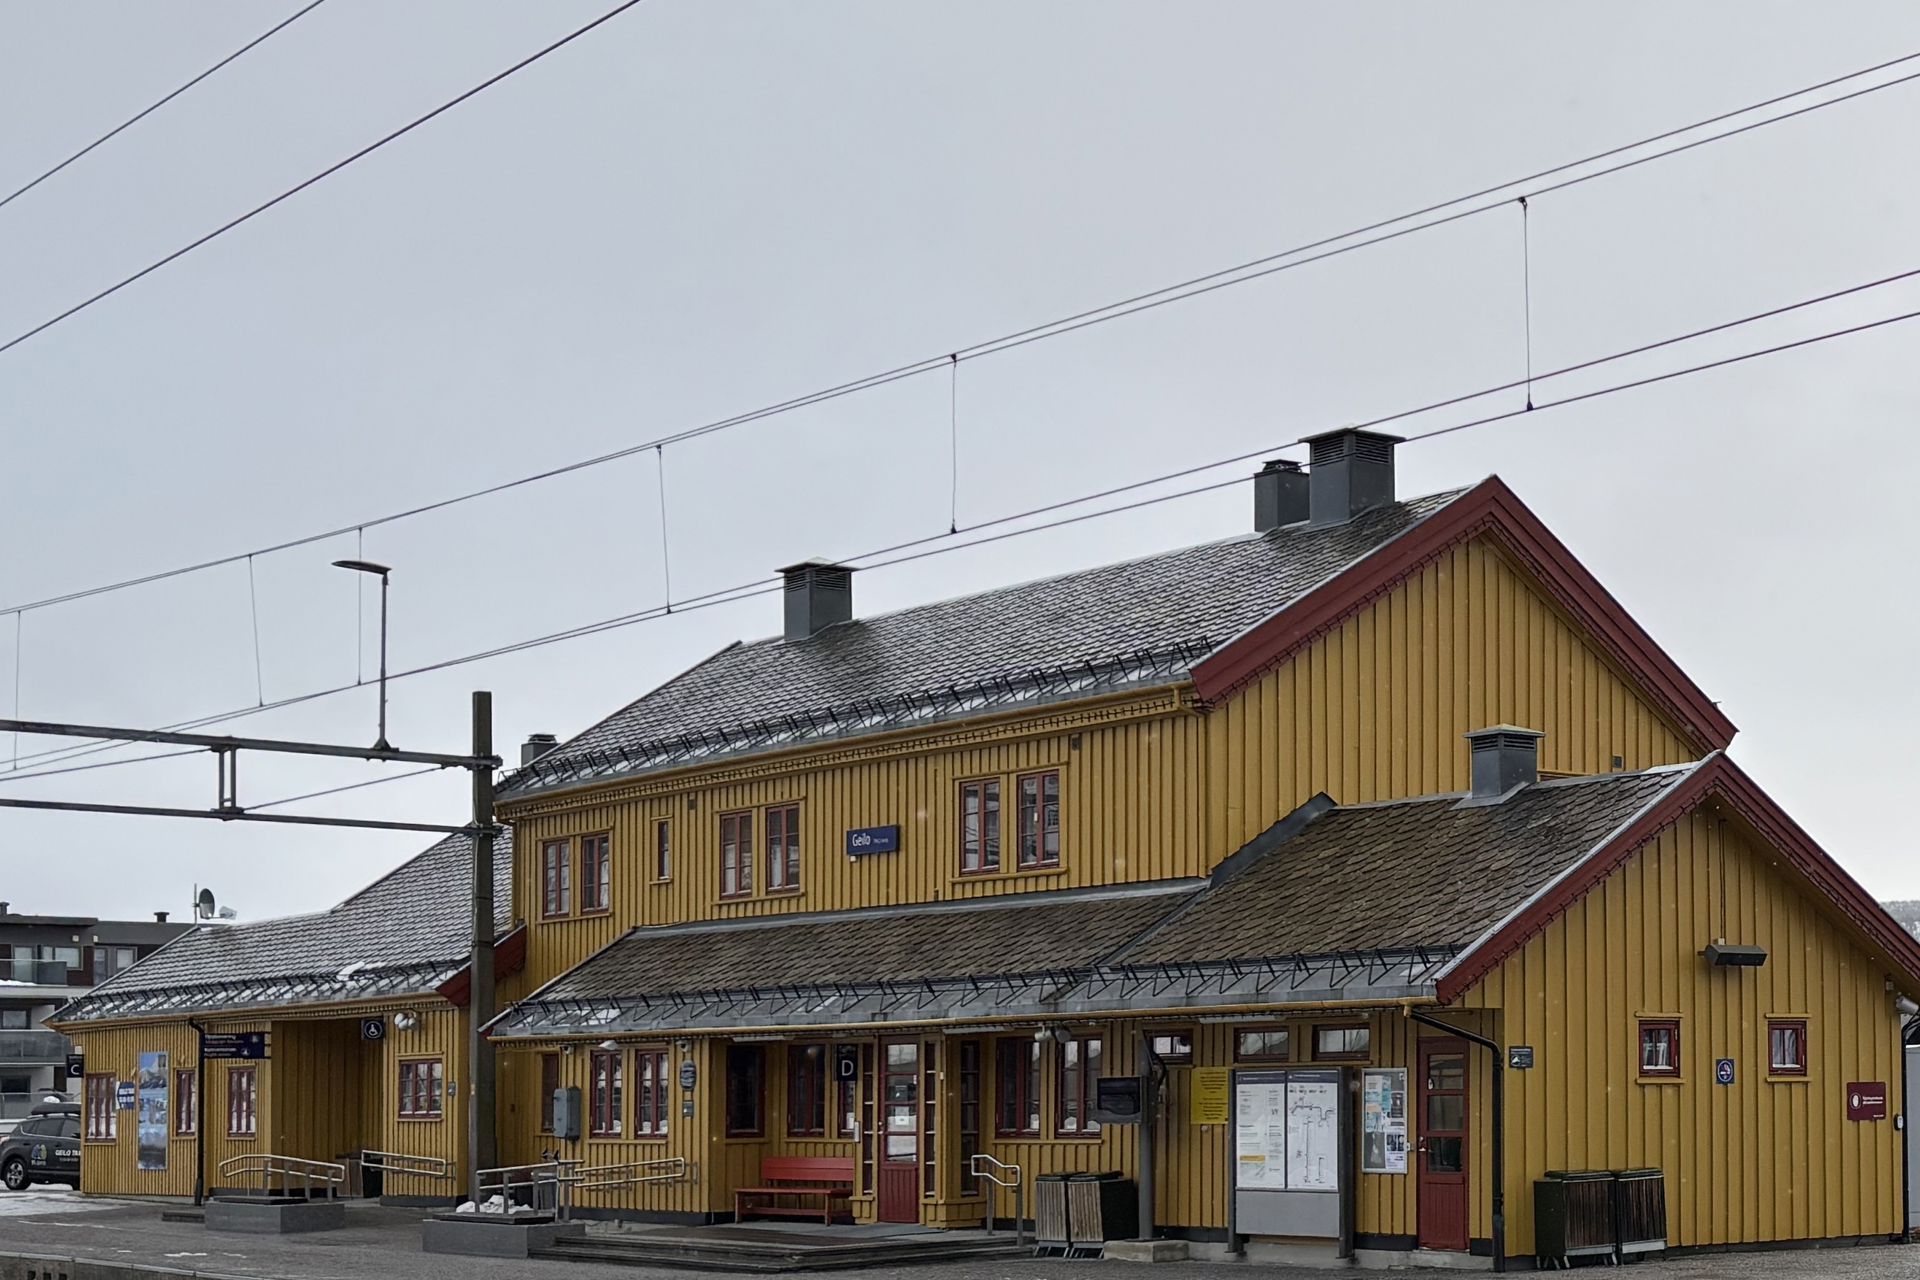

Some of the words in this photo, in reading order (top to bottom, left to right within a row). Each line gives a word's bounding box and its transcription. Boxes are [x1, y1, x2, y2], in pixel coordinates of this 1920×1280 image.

[852, 833, 871, 846] Geilo
[70, 1064, 80, 1075] C
[841, 1060, 854, 1076] D
